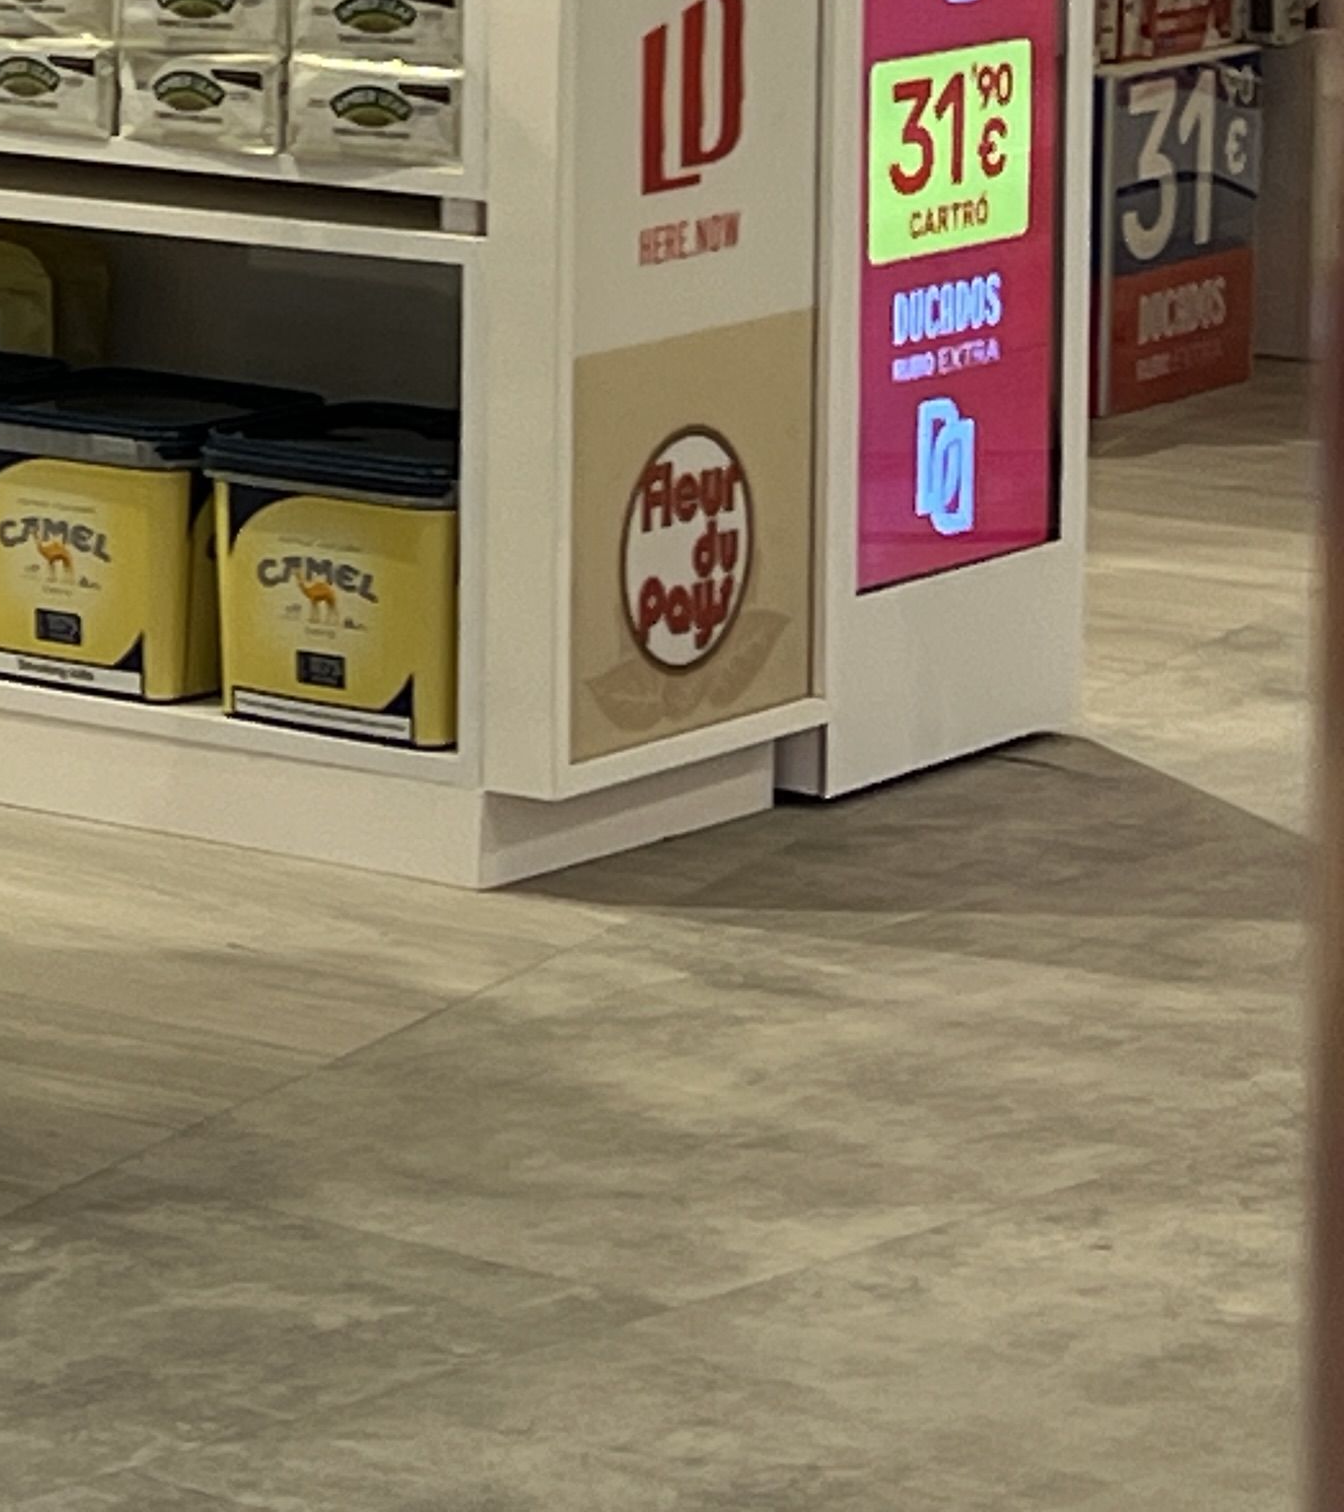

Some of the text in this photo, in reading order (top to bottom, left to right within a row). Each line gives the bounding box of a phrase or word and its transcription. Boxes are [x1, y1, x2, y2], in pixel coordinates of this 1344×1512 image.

[889, 66, 966, 197] 31
[978, 116, 1009, 179] €
[1121, 67, 1220, 264] 31
[909, 198, 990, 241] CARTRÓ
[892, 274, 1003, 347] DUCADOS
[1135, 276, 1227, 348] DUCADOS
[937, 337, 1001, 377] EXTRA
[641, 461, 744, 533] Fleur
[257, 555, 378, 602] CAMEL
[692, 522, 741, 578] du
